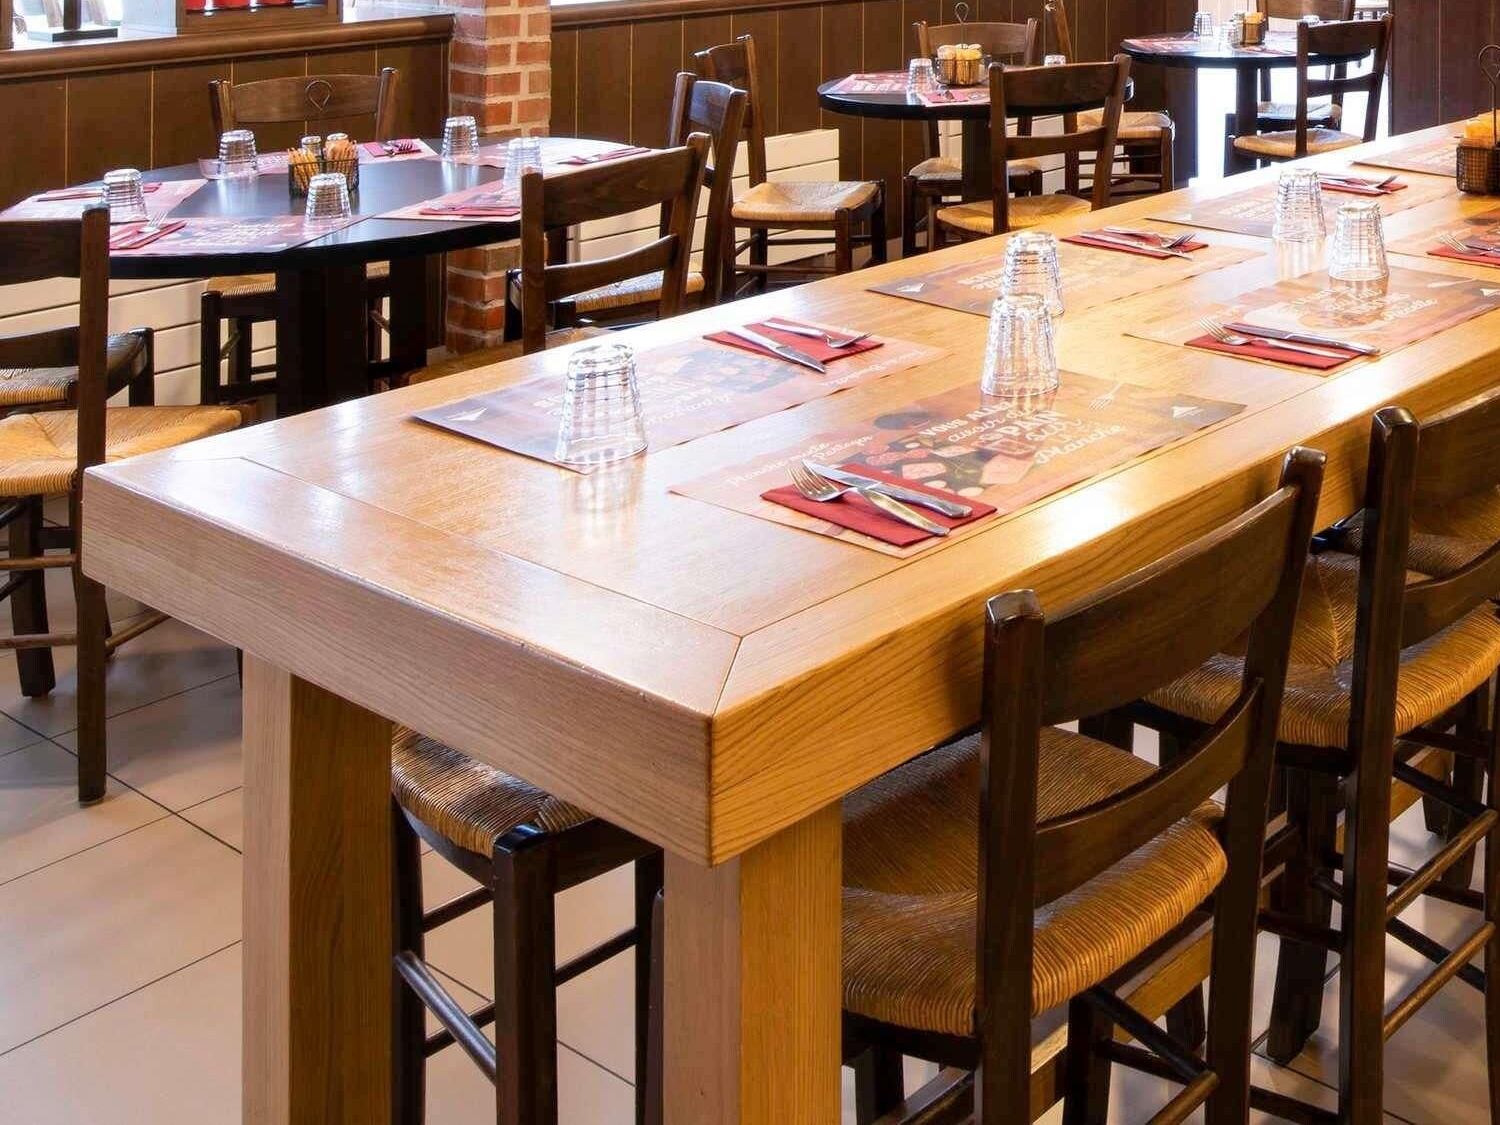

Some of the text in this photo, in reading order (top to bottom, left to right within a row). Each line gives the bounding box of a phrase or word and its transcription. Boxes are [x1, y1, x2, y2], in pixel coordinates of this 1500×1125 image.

[919, 400, 1017, 437] VOUS ALLEZ
[1000, 410, 1066, 436] PAIN
[1034, 424, 1126, 464] Planche
